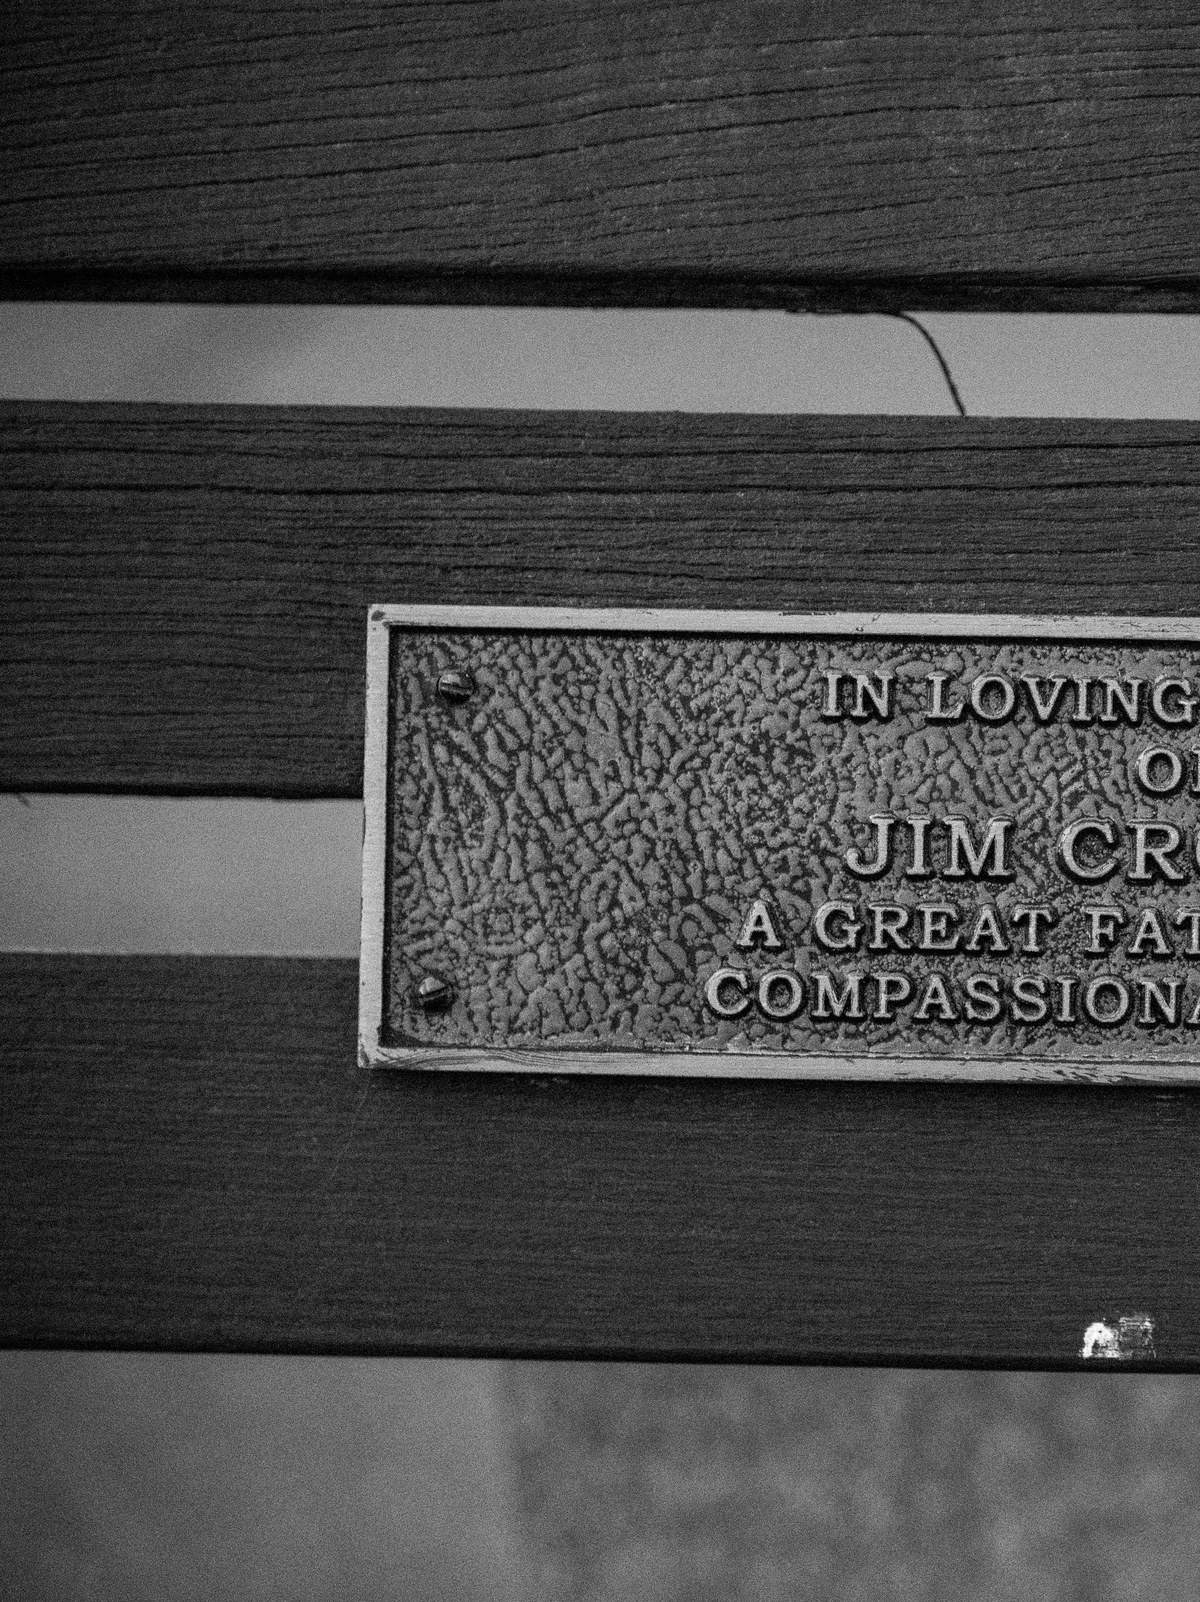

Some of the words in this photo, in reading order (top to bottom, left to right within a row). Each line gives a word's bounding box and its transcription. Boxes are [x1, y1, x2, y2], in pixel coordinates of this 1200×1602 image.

[824, 670, 893, 719] IN
[925, 672, 1197, 725] LOVING
[846, 813, 1015, 880] JIM
[736, 900, 782, 948] A
[814, 903, 1053, 952] GREAT
